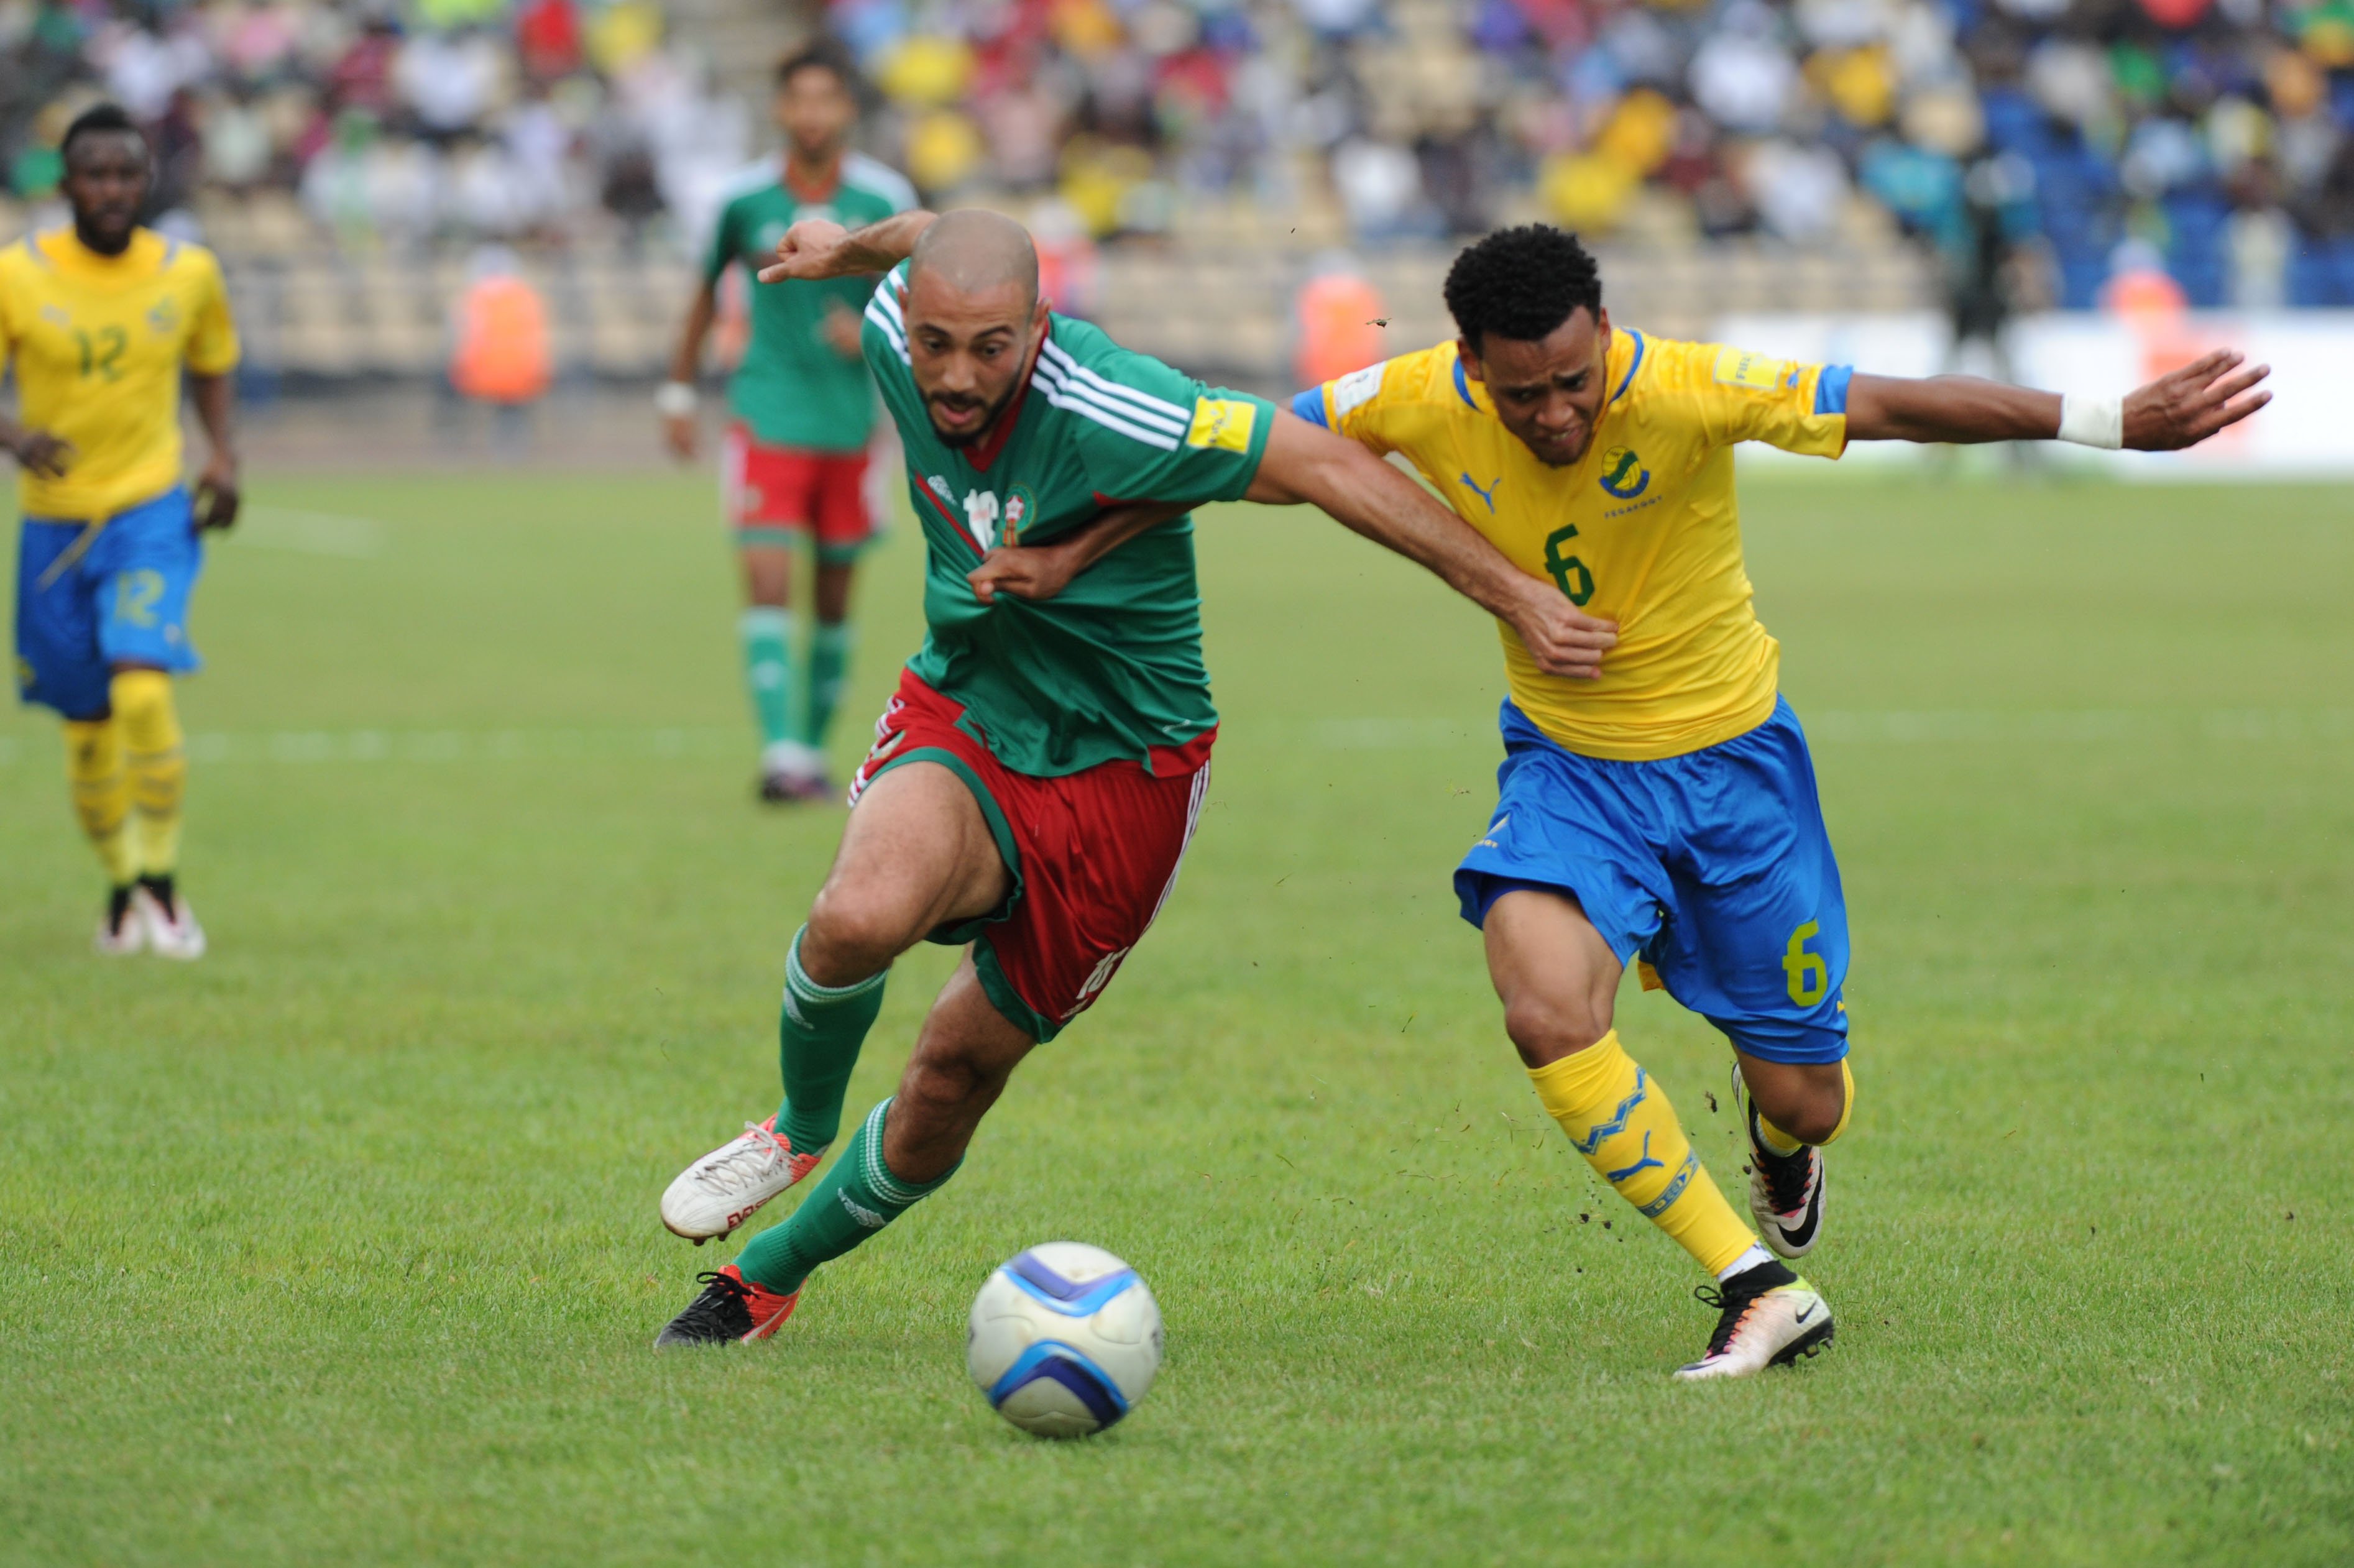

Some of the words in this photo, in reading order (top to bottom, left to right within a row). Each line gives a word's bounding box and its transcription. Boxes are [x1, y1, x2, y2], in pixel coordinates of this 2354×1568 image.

[71, 324, 128, 383] 12
[116, 568, 165, 630] 12
[1544, 522, 1596, 607] 6
[1782, 917, 1828, 1007] 6
